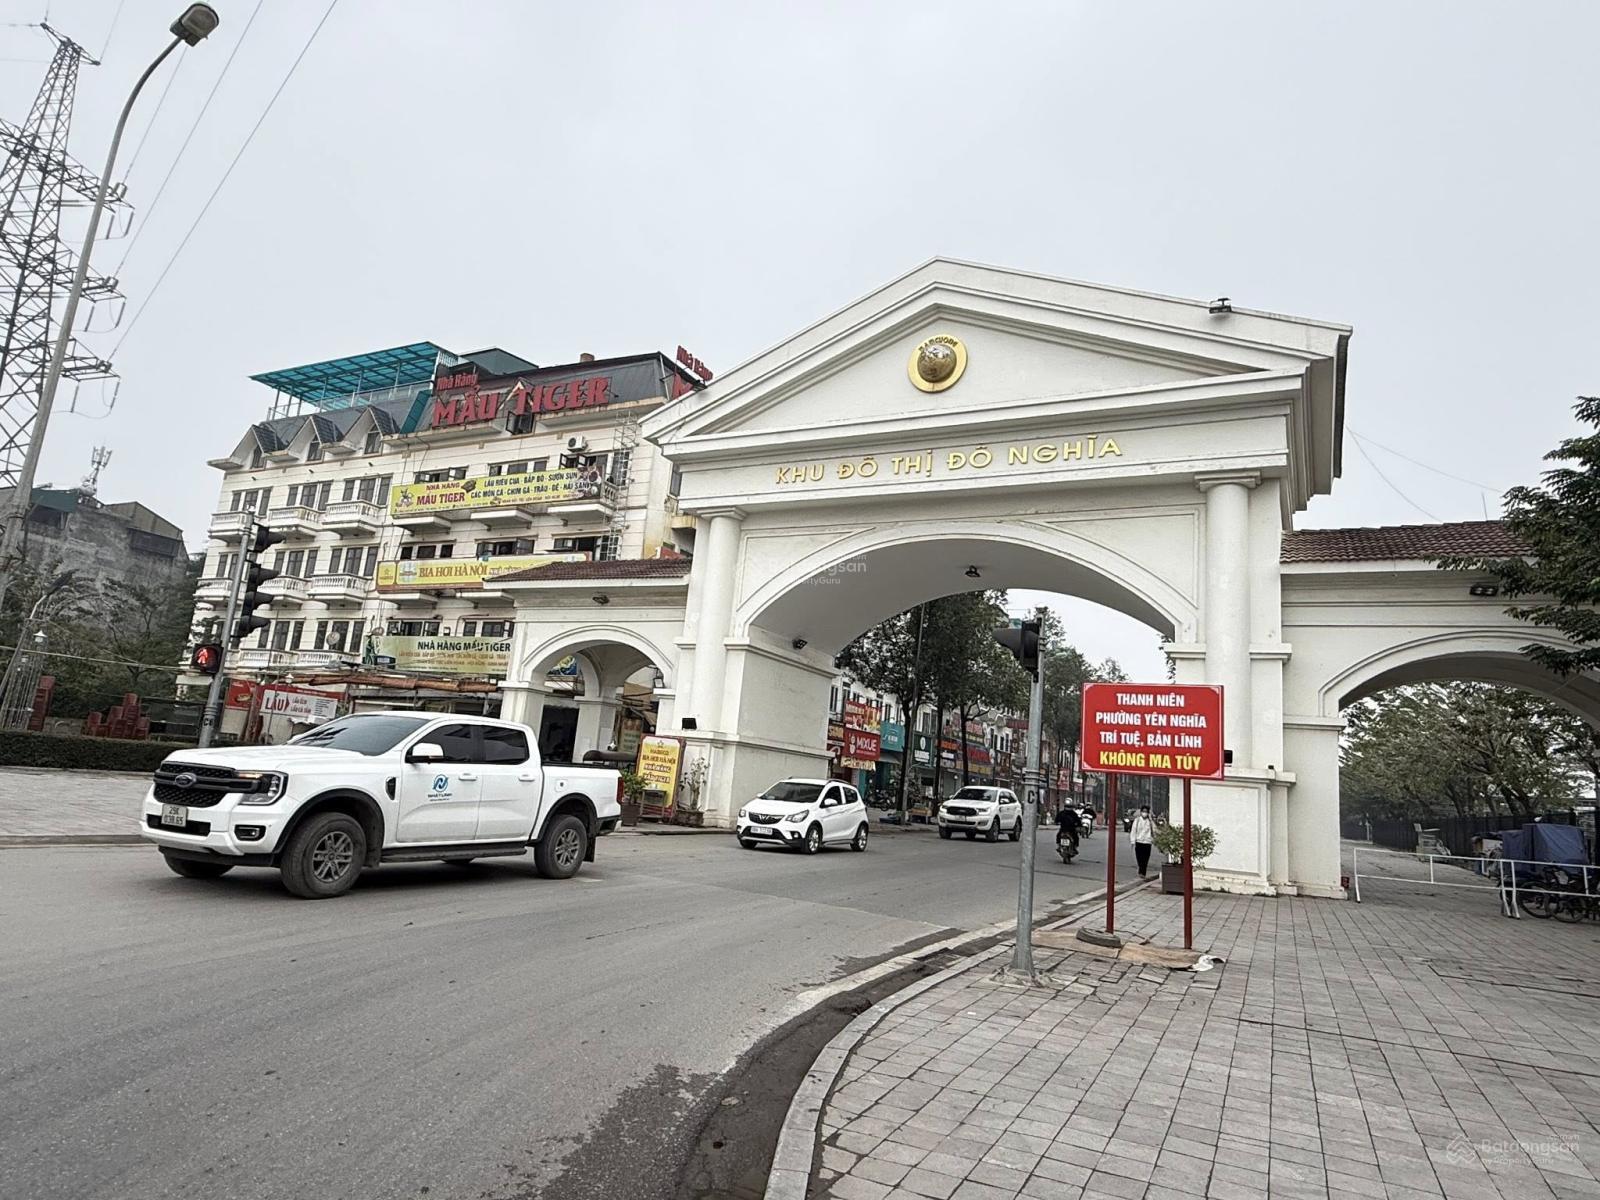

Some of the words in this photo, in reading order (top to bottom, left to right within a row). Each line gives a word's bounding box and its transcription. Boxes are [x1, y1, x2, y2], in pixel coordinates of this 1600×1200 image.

[432, 385, 498, 427] MẨU
[511, 377, 609, 415] TIGER
[775, 463, 825, 485] KHU
[837, 456, 879, 479] ĐÔ
[891, 449, 933, 478] THỊ
[1008, 435, 1123, 465] NGHĨA
[439, 492, 465, 503] TIGER
[419, 566, 434, 577] BIA
[454, 563, 468, 577] HÀ
[470, 562, 487, 578] NỘI
[417, 640, 435, 651] NHÀ
[436, 640, 461, 651] HÀNG
[485, 641, 511, 652] TIGER
[1116, 693, 1154, 707] THANH
[1156, 692, 1185, 707] NIÊN
[1095, 710, 1141, 726] PHƯỜNG
[1144, 711, 1167, 727] YÊN
[1170, 713, 1207, 728] NGHĨA
[856, 736, 877, 752] MIXUE
[1099, 729, 1117, 744] TRÍ
[1119, 731, 1144, 748] TUỆ,
[1147, 730, 1171, 747] BẢN
[1174, 733, 1202, 748] LĨNH
[1099, 749, 1145, 767] KHÔNG
[1149, 754, 1172, 769] MA
[1175, 753, 1202, 771] TÚY
